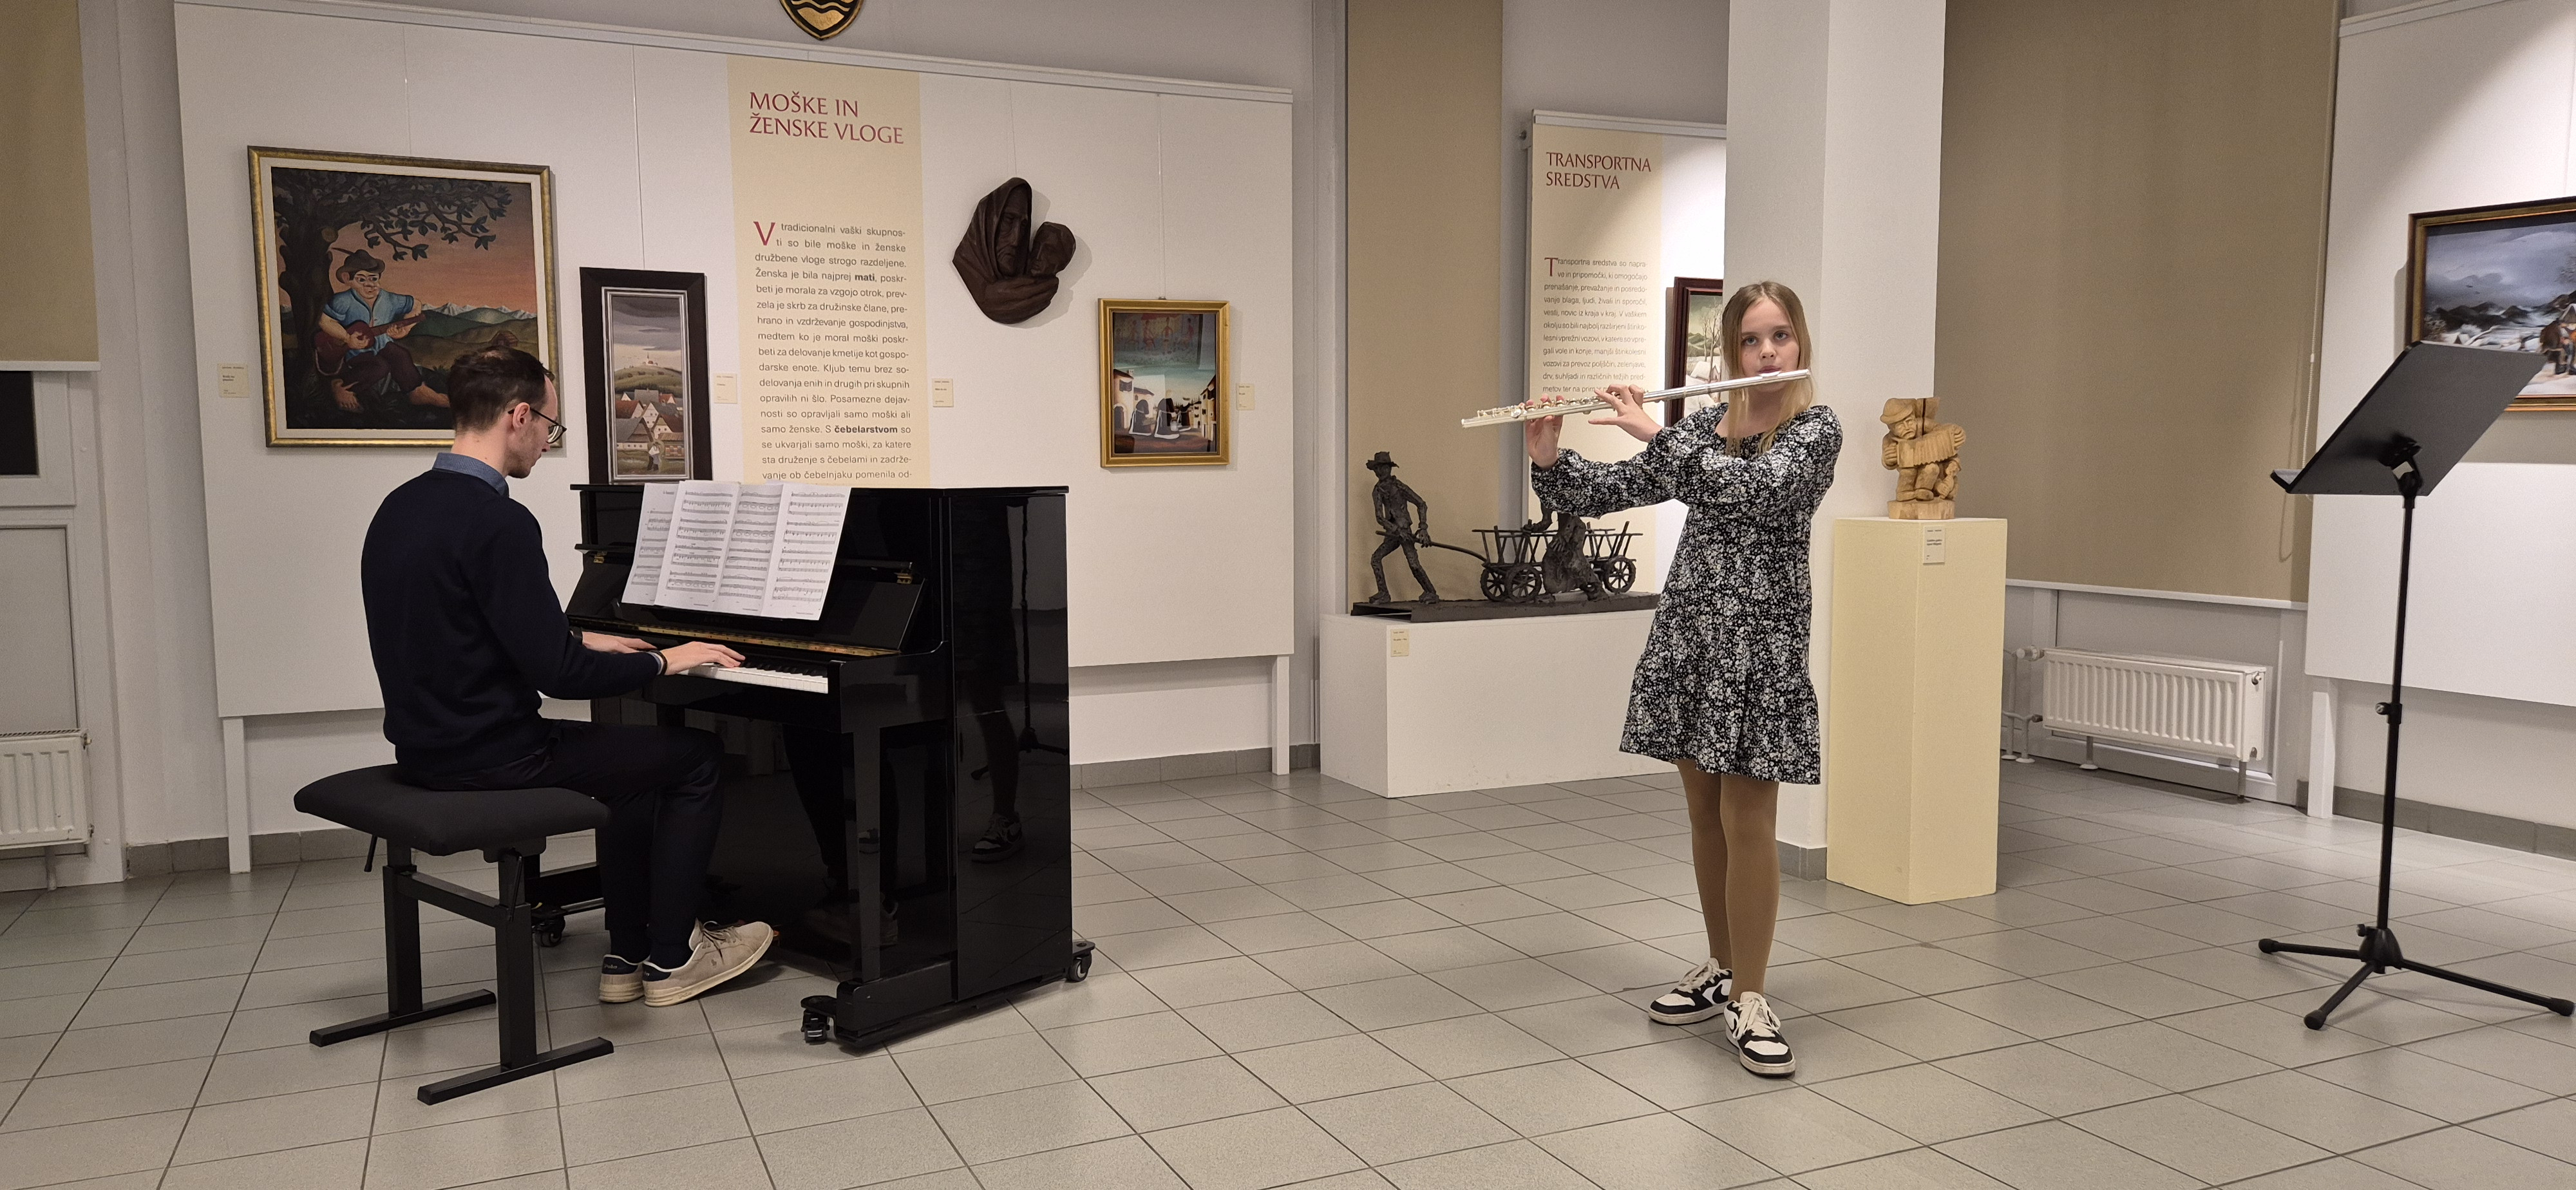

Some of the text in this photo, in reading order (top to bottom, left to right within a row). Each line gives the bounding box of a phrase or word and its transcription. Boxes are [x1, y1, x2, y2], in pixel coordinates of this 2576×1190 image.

[750, 91, 858, 118] MOŠKE IN
[749, 113, 904, 144] ŽENSKE VLOGE
[1546, 152, 1651, 189] TRANSPORTNA SREDSTVA
[753, 222, 906, 246] V tradicionalni vaški skupnos-
[776, 238, 782, 247] ti
[804, 240, 821, 248] bile
[826, 241, 857, 250] moške
[862, 242, 870, 250] in
[875, 243, 906, 252] ženske
[755, 253, 906, 268] družbene vloge strogo razdeljene.
[755, 267, 907, 283] Ženska je bila najprej mati, poskr-
[756, 285, 773, 293] beti
[775, 285, 784, 295] je
[829, 288, 858, 298] vzgojo
[860, 289, 884, 298] otrok,
[757, 301, 775, 309] zela
[777, 301, 785, 310] je
[786, 301, 806, 310] skrb
[819, 302, 862, 312] družinske
[863, 304, 889, 313] člane,
[757, 316, 783, 325] hrano
[796, 317, 846, 328] vzdrževanje
[849, 319, 908, 330] gospodinjstva,
[813, 334, 821, 343] je
[853, 334, 878, 343] moški
[882, 335, 909, 345] poskr-
[788, 348, 831, 358] delovanje
[832, 348, 864, 359] kmetije
[865, 350, 878, 358] kot
[759, 363, 789, 372] darske
[823, 364, 846, 373] Kljub
[874, 365, 893, 373] brez
[759, 379, 802, 388] delovanja
[833, 379, 862, 389] drugih
[876, 380, 910, 390] skupnih
[759, 394, 797, 404] opravilih
[811, 394, 827, 402] šlo.
[830, 395, 882, 403] Posamezne
[884, 395, 911, 405] dejav-
[800, 410, 840, 419] opravljali
[825, 425, 831, 433] S
[834, 425, 898, 433] čebelarstvom
[775, 440, 812, 450] ukvarjali
[842, 440, 870, 449] moški,
[778, 455, 818, 465] druženje
[762, 471, 787, 481] vanje
[804, 471, 853, 480] čebelnjaku
[855, 470, 895, 479] pomenila
